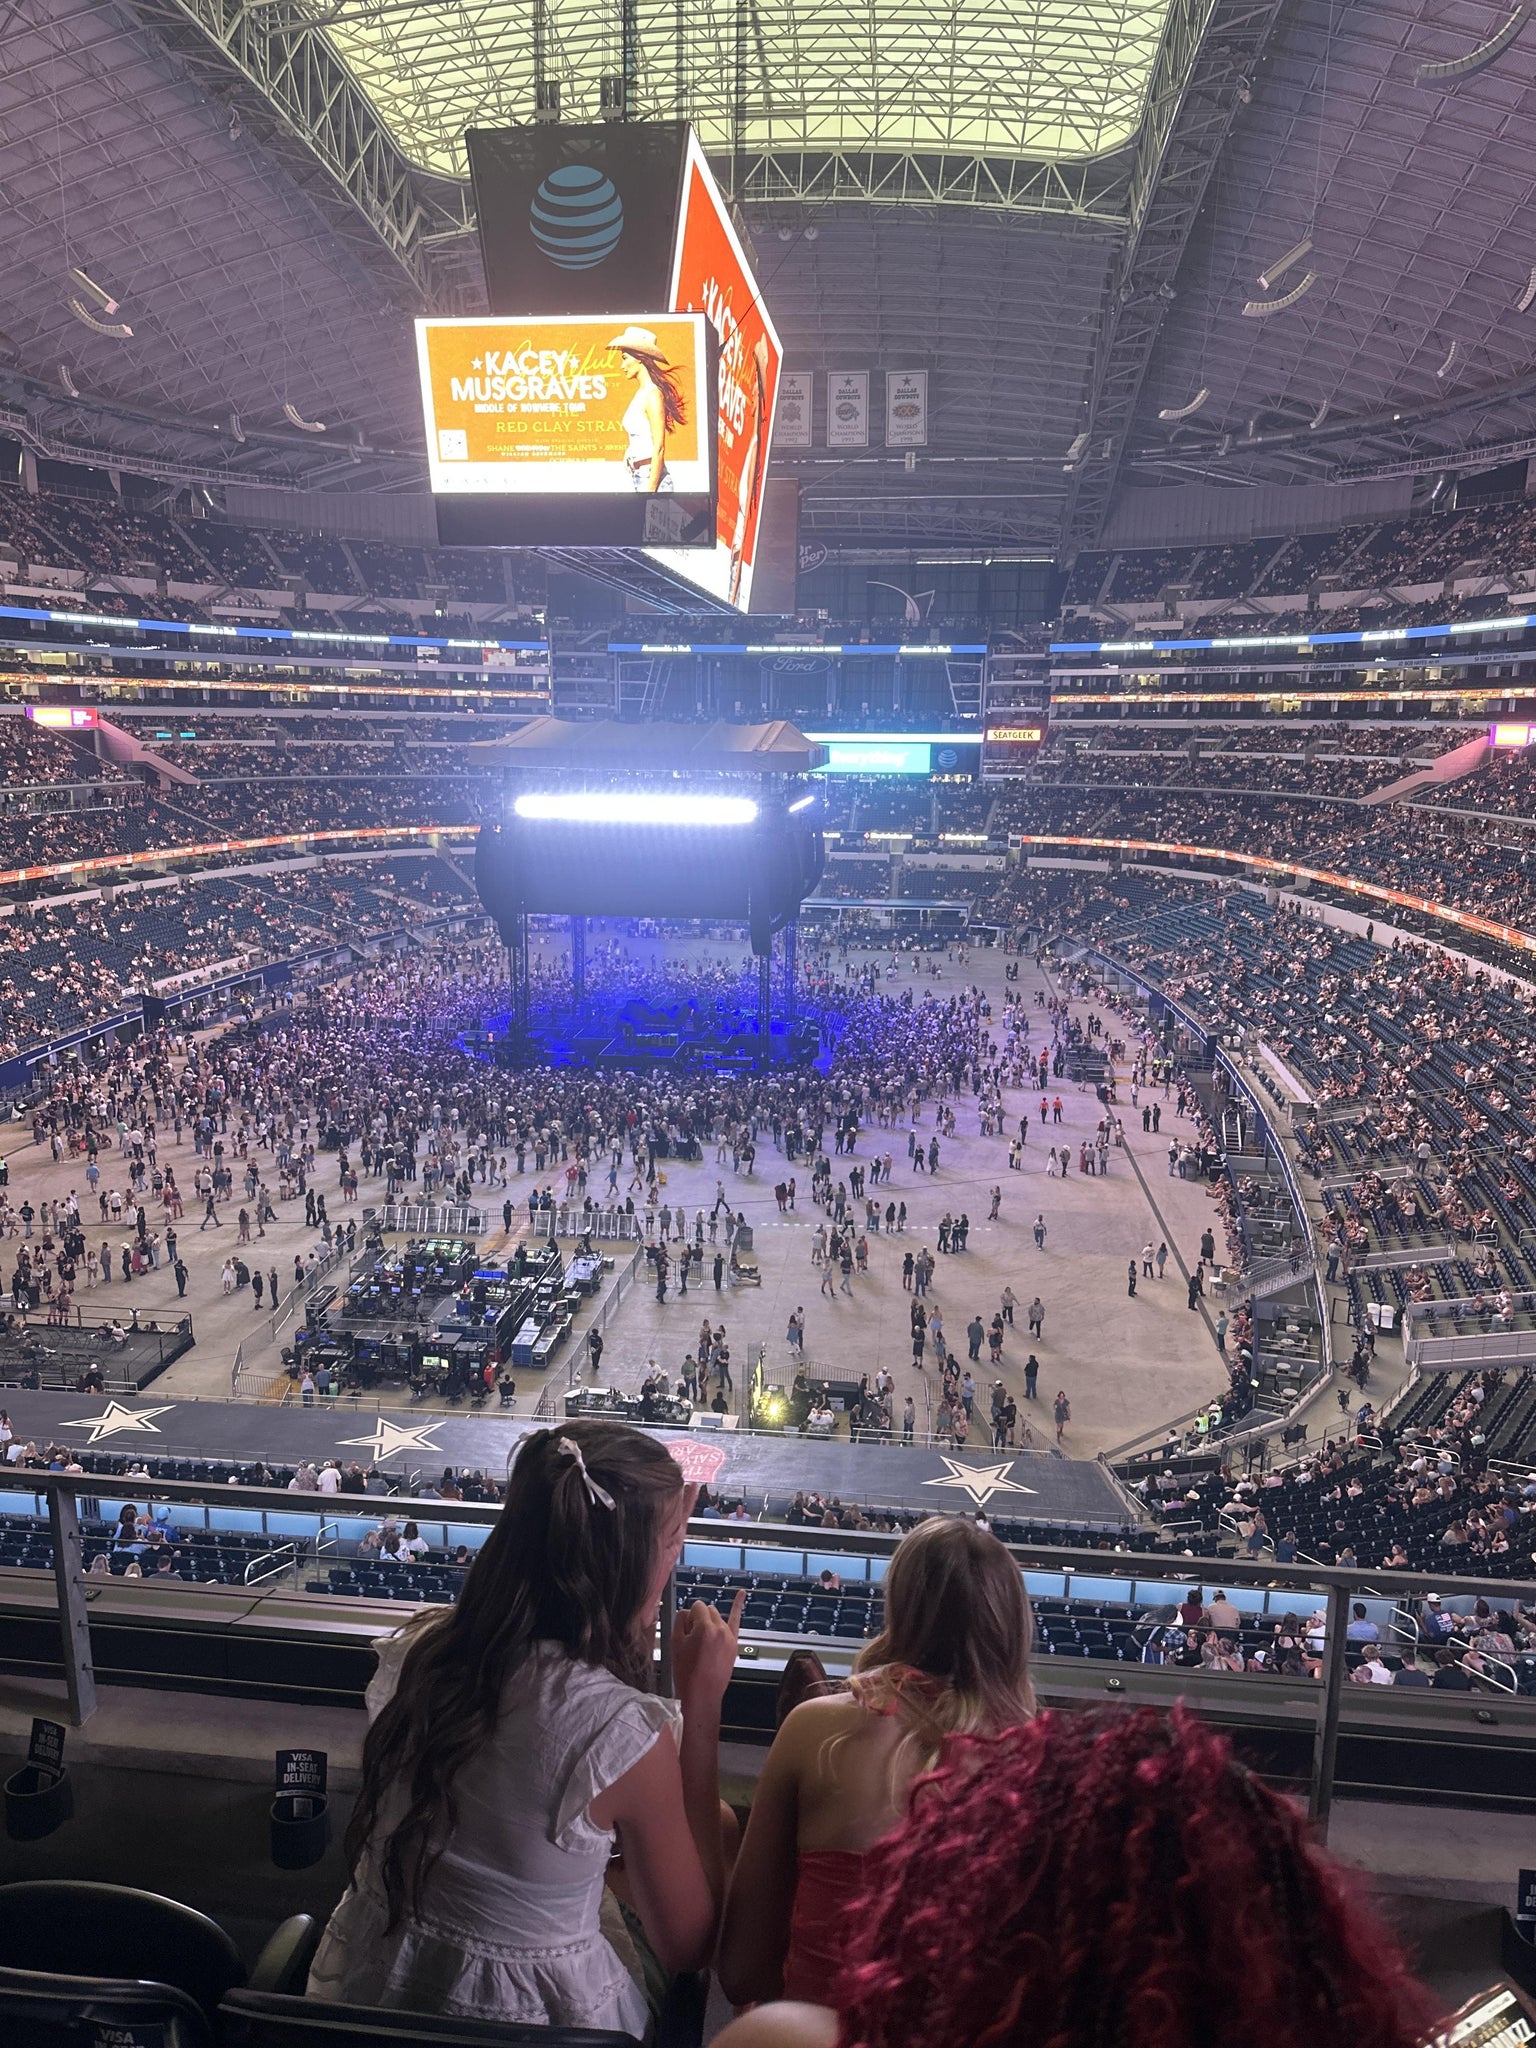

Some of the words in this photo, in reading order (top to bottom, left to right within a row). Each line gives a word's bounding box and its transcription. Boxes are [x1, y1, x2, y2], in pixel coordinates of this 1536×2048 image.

[485, 350, 569, 376] KACEY
[451, 375, 607, 401] MUSGRAVES
[496, 422, 528, 433] RED
[533, 421, 572, 433] CLAY
[576, 421, 625, 432] STRAY
[772, 655, 817, 671] Ford
[993, 731, 1034, 739] SEATGEEK
[290, 1753, 313, 1762] VISA
[287, 1762, 318, 1773] IN-SEAT
[283, 1773, 321, 1785] DELIVERY
[101, 2029, 135, 2044] VISA
